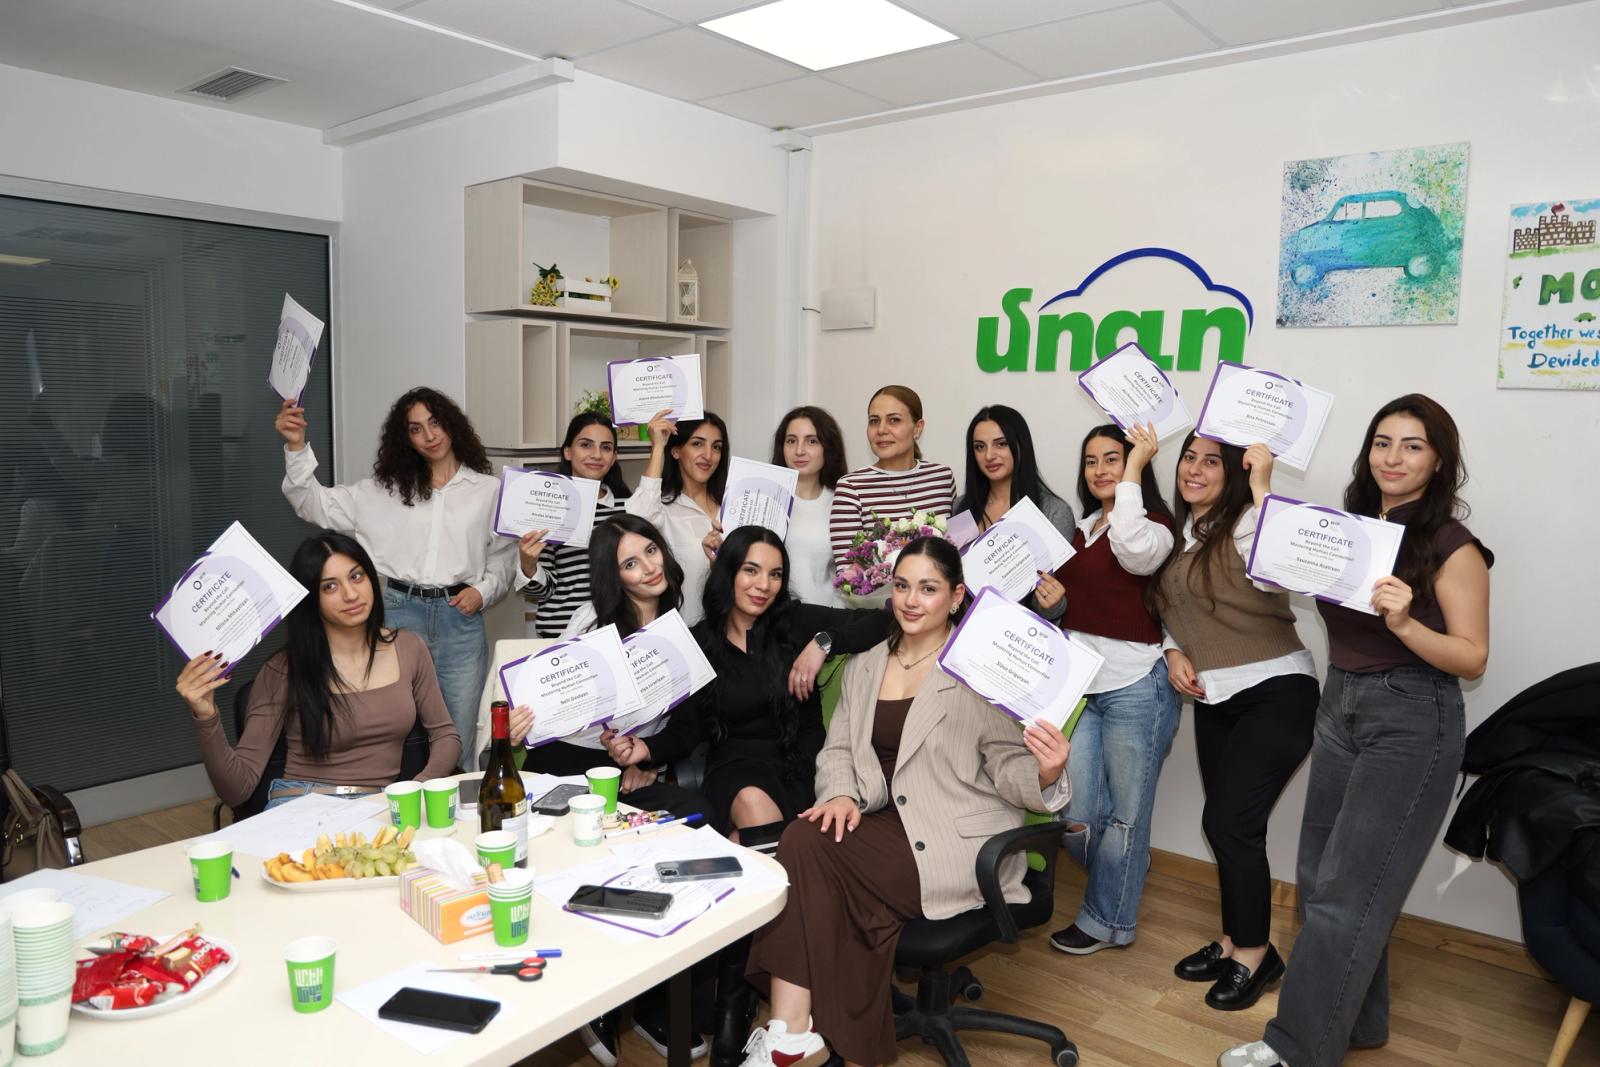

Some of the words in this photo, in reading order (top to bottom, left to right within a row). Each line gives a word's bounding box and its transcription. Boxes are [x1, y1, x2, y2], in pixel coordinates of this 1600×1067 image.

[1507, 323, 1574, 349] Together
[1133, 371, 1162, 402] CERTIFICATE
[1245, 388, 1293, 407] CERTIFICATE
[529, 489, 568, 500] CERTIFICATE
[983, 533, 1018, 563] CERTIFICATE
[1297, 528, 1353, 547] CERTIFICATE
[191, 571, 232, 612] CERTIFICATE
[631, 649, 658, 667] IFICATE
[1004, 629, 1054, 664] CERTIFICATE
[540, 660, 588, 684] CERTIFICATE
